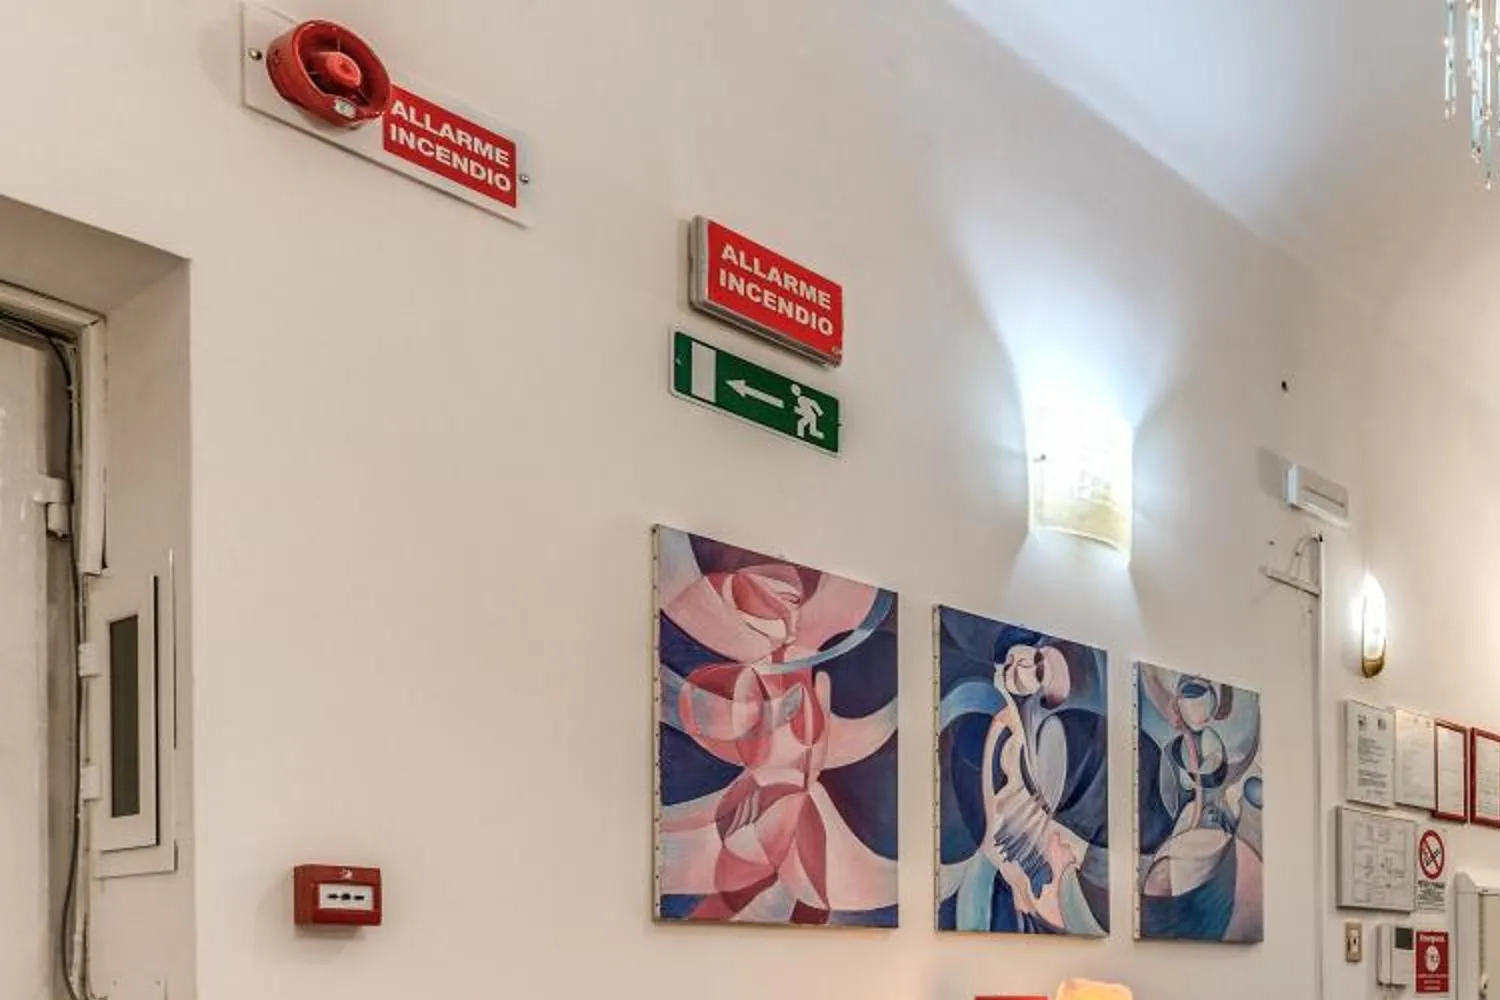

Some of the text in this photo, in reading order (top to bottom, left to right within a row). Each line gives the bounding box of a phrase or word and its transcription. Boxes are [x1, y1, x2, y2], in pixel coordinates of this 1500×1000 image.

[390, 123, 512, 192] INCENDIO
[391, 99, 511, 169] ALLARME
[719, 267, 833, 336] INCENDIO
[721, 243, 832, 311] ALLARME
